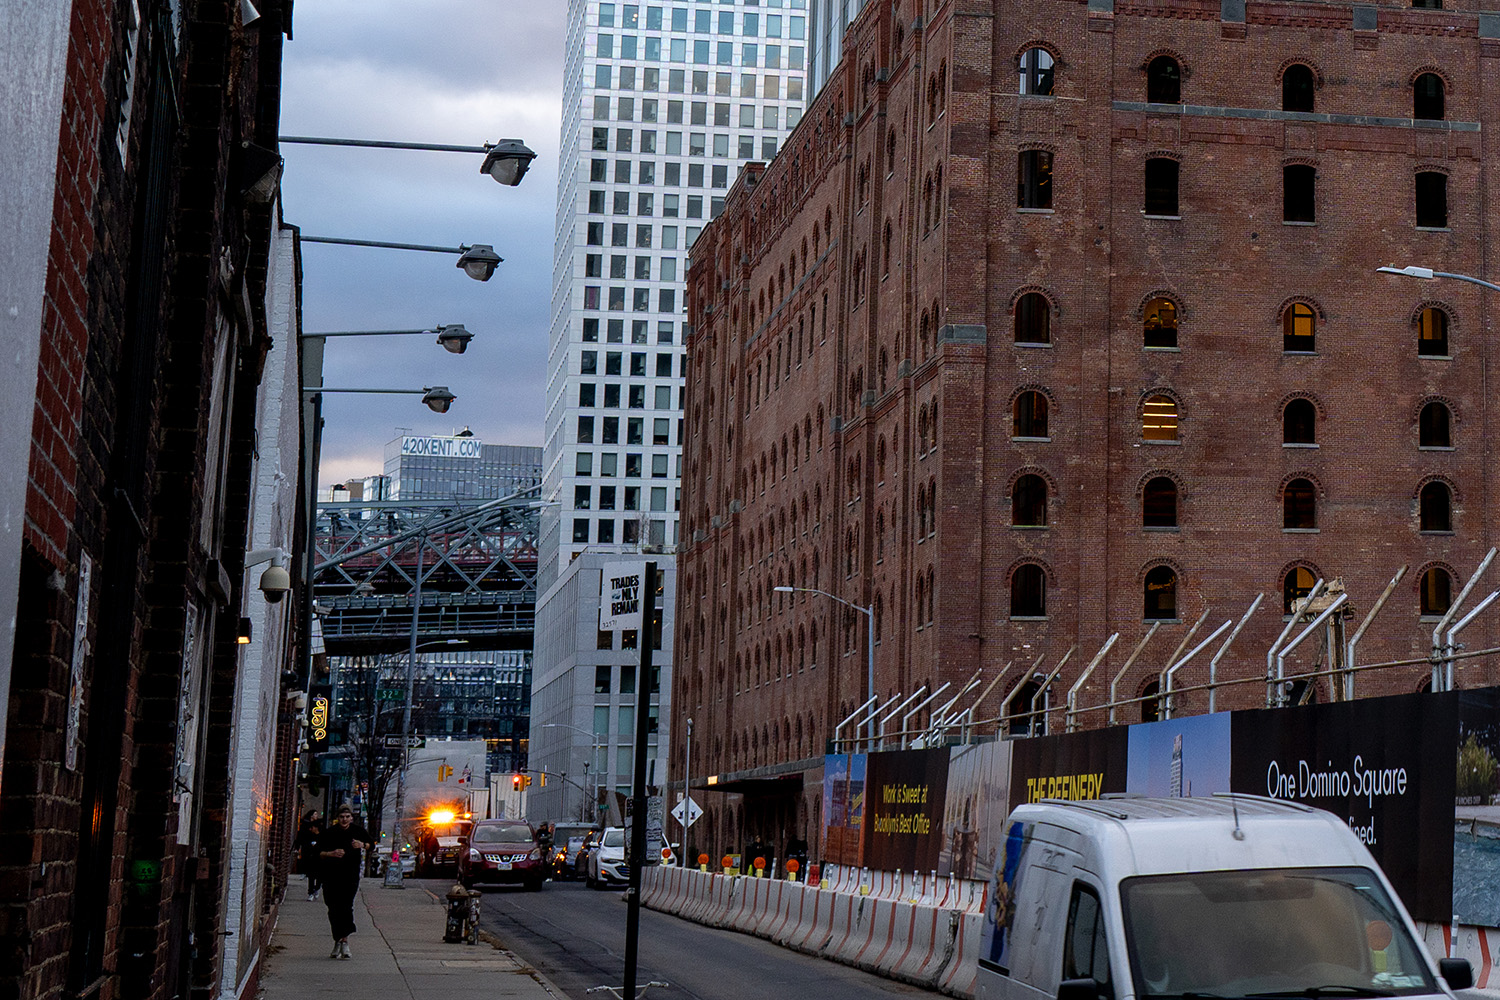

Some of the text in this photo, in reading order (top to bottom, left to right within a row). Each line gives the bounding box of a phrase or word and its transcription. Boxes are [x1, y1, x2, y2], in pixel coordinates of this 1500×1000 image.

[402, 438, 482, 456] 420KENT.COM
[1027, 772, 1104, 803] THE REFINERY
[1267, 754, 1407, 809] One Domino Square
[883, 783, 896, 803] Work
[897, 783, 902, 803] is
[902, 783, 921, 803] Sweet
[921, 784, 929, 803] at
[900, 813, 912, 833] Best
[913, 813, 930, 834] Office
